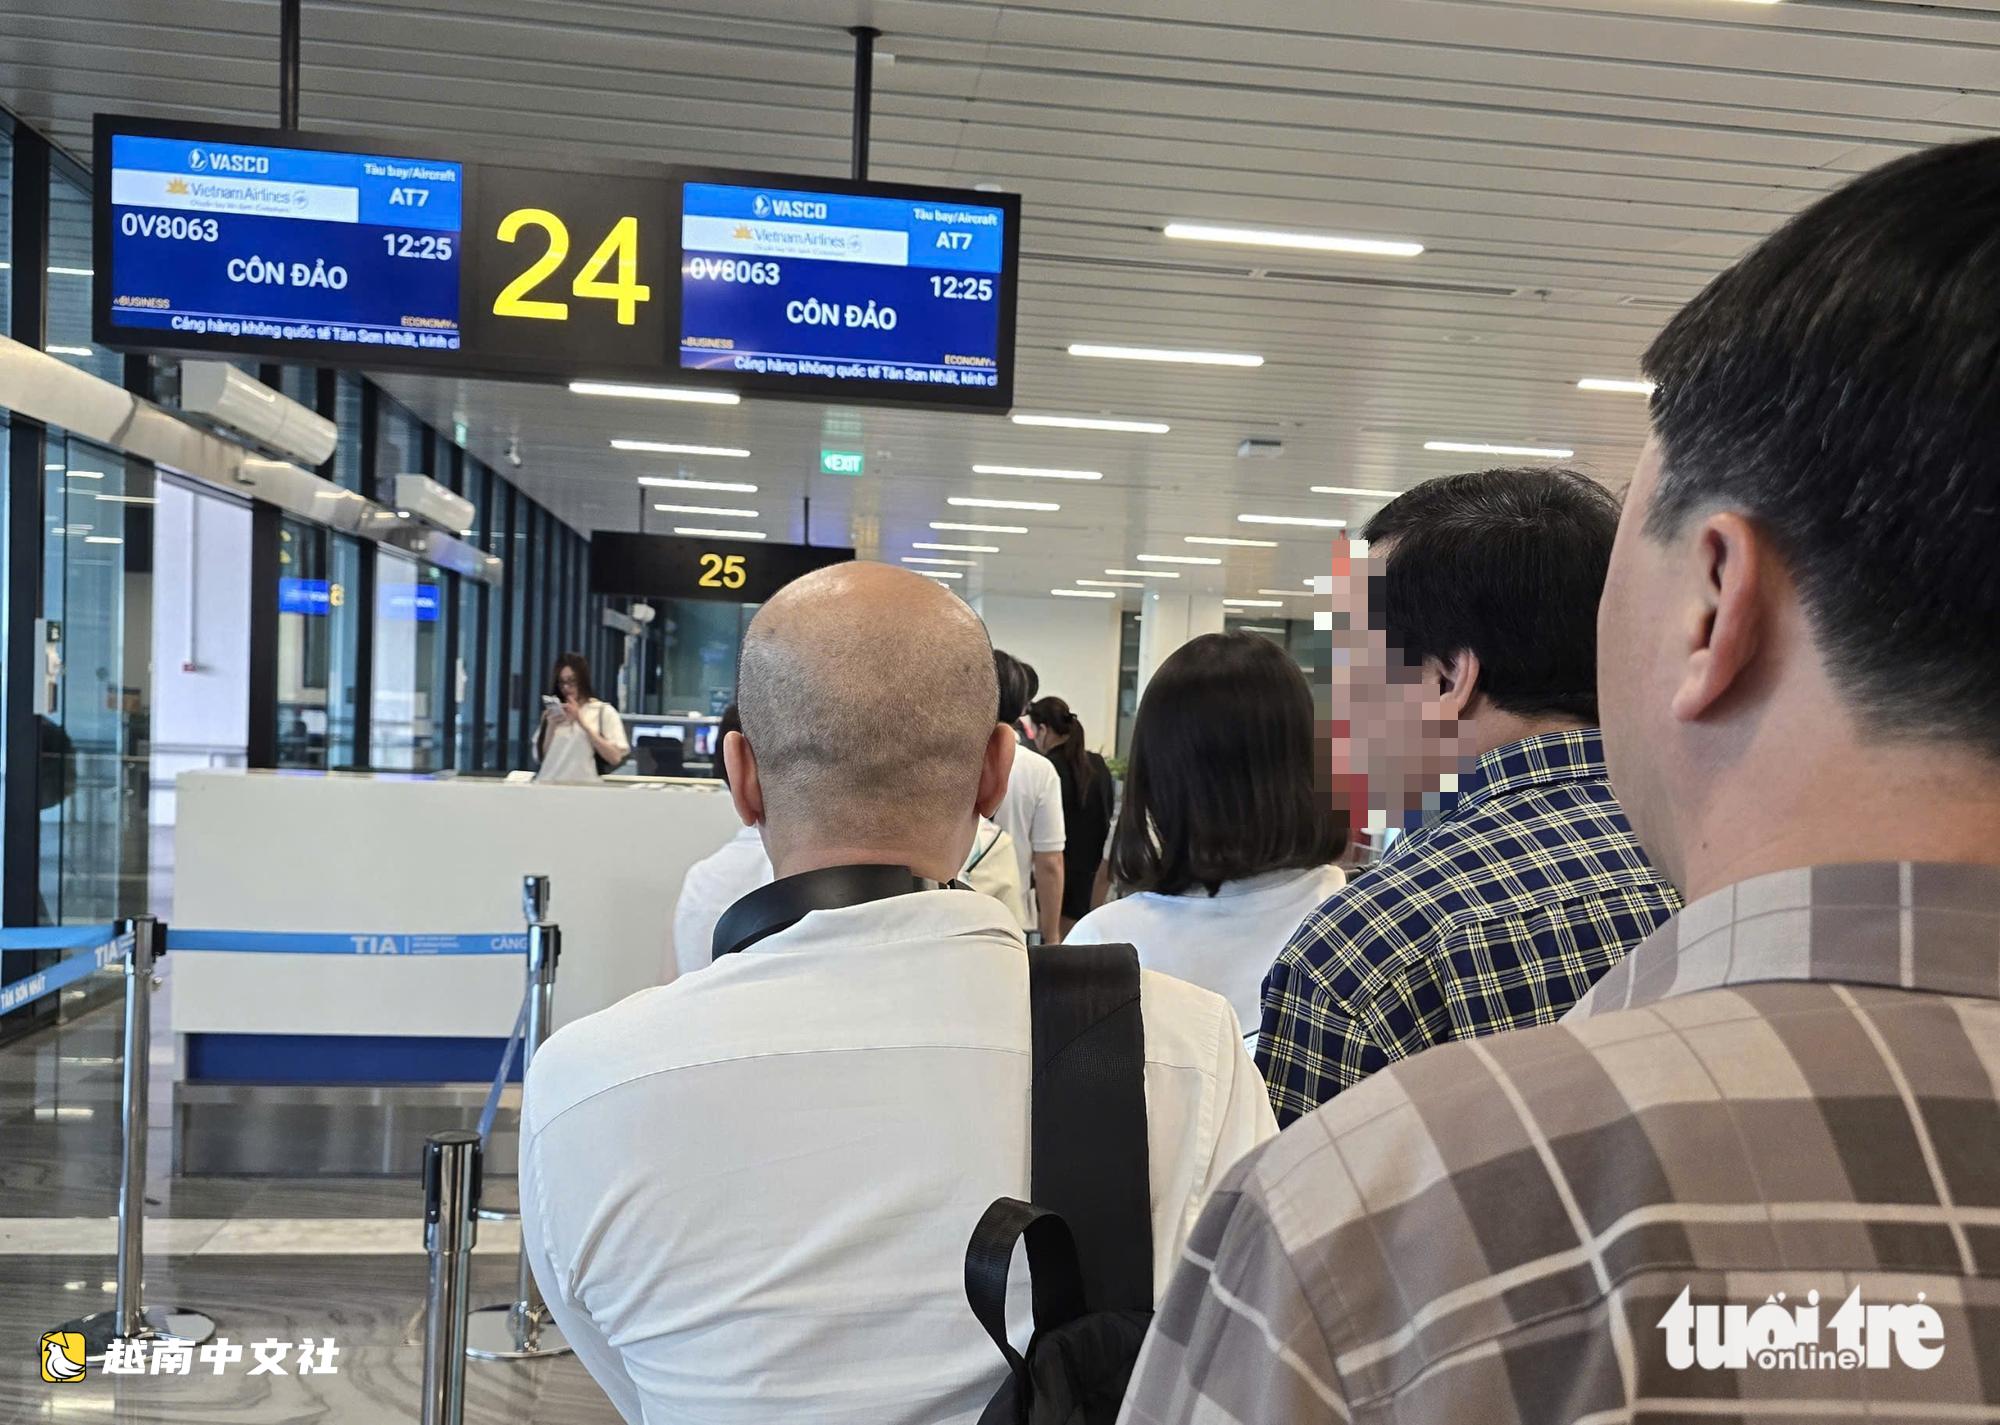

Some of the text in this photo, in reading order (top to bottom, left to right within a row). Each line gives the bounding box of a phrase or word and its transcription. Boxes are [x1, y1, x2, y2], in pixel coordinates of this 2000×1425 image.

[210, 152, 269, 174] VASCO
[389, 187, 430, 207] AT7
[772, 200, 828, 220] VASCO
[382, 233, 452, 261] 12:25
[936, 231, 973, 250] AT7
[227, 255, 349, 290] CÔN ĐẢO
[493, 208, 650, 325] 24
[930, 275, 993, 301] 12:25
[786, 297, 897, 330] CÔN ĐẢO
[831, 453, 863, 472] EXIT
[699, 553, 746, 589] 25
[95, 940, 119, 968] TIA
[350, 936, 398, 954] TIA
